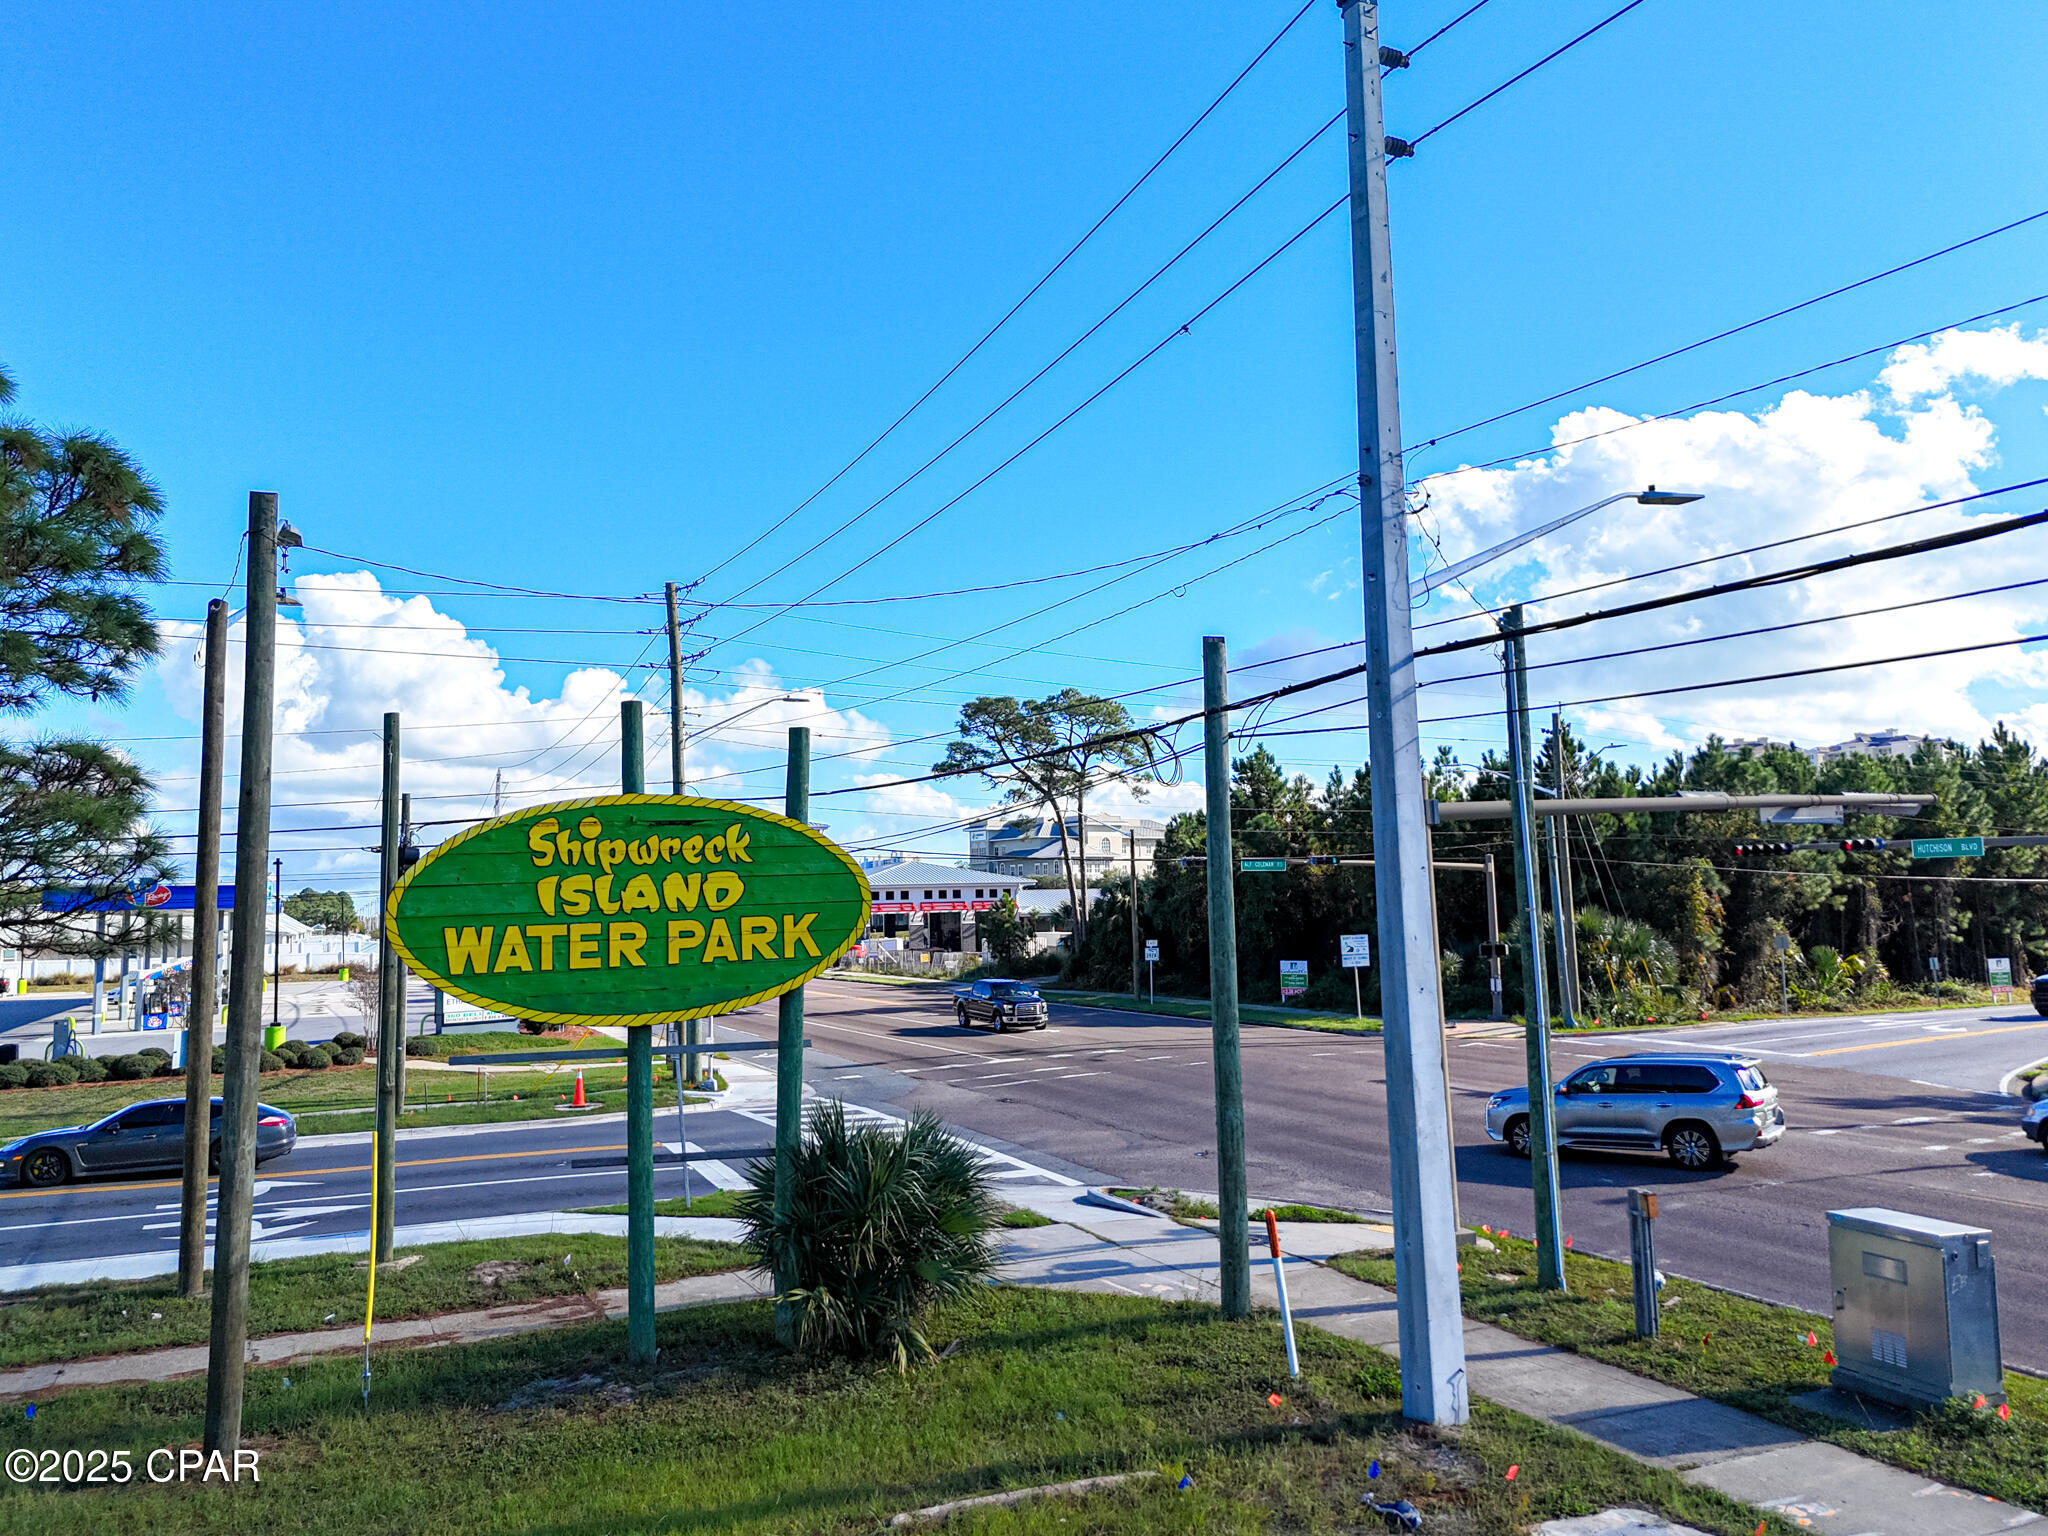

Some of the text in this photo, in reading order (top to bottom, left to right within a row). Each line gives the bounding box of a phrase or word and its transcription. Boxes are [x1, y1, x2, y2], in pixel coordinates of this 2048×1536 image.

[528, 816, 754, 874] Shipwreck
[1917, 842, 1978, 854] HUTCHISON BLVD
[536, 871, 746, 917] ISLAND
[443, 913, 823, 976] WATER PARK
